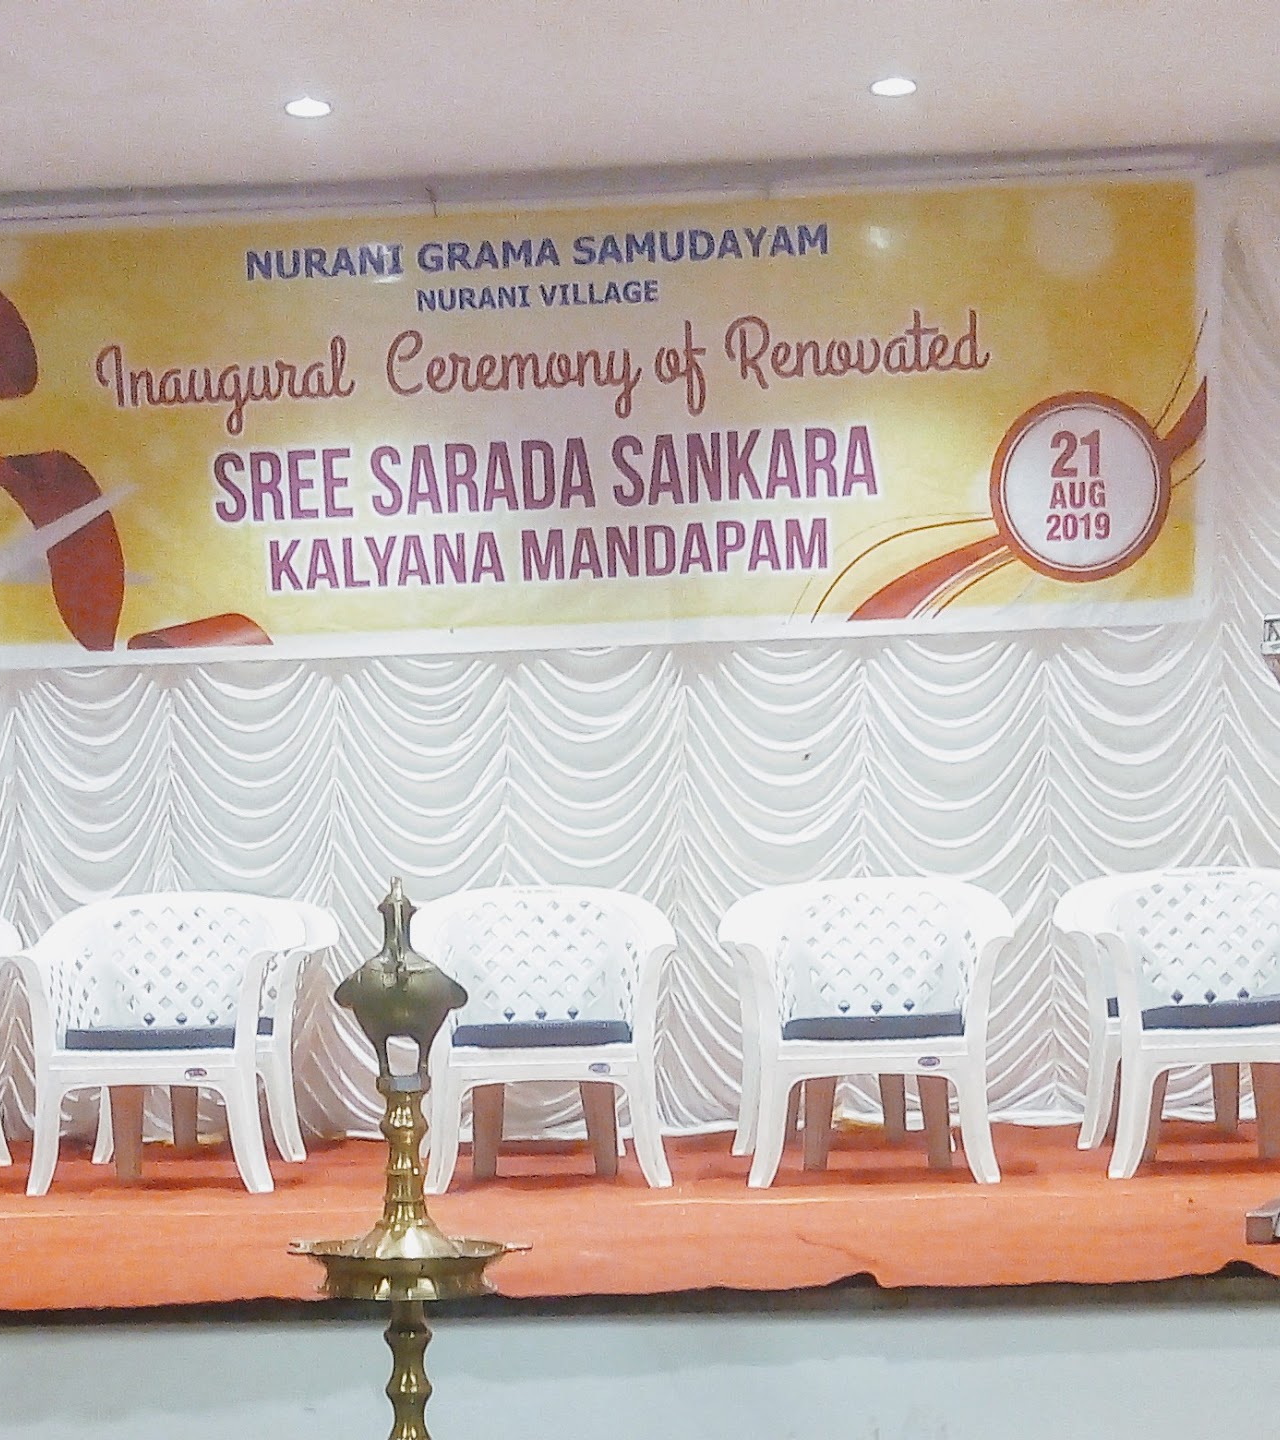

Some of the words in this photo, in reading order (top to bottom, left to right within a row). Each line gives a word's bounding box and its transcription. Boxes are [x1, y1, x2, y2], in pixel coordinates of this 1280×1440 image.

[245, 242, 404, 281] NURANI
[417, 237, 561, 274] GRAMA
[572, 224, 830, 267] SAMUDAYAM
[416, 284, 531, 313] NURANI
[540, 279, 660, 307] VILLAGE
[95, 335, 355, 437] Inaugural
[387, 329, 642, 419] Ceremony
[654, 319, 707, 418] of
[724, 309, 991, 390] Renovated
[214, 447, 354, 523] SREE
[370, 437, 596, 517] SARADA
[612, 425, 879, 507] SANKARA
[1050, 429, 1100, 478] 21
[1049, 479, 1107, 510] AUG
[1046, 512, 1110, 542] 2019
[269, 531, 506, 592] KALYANA
[521, 518, 828, 583] MANDAPAM
